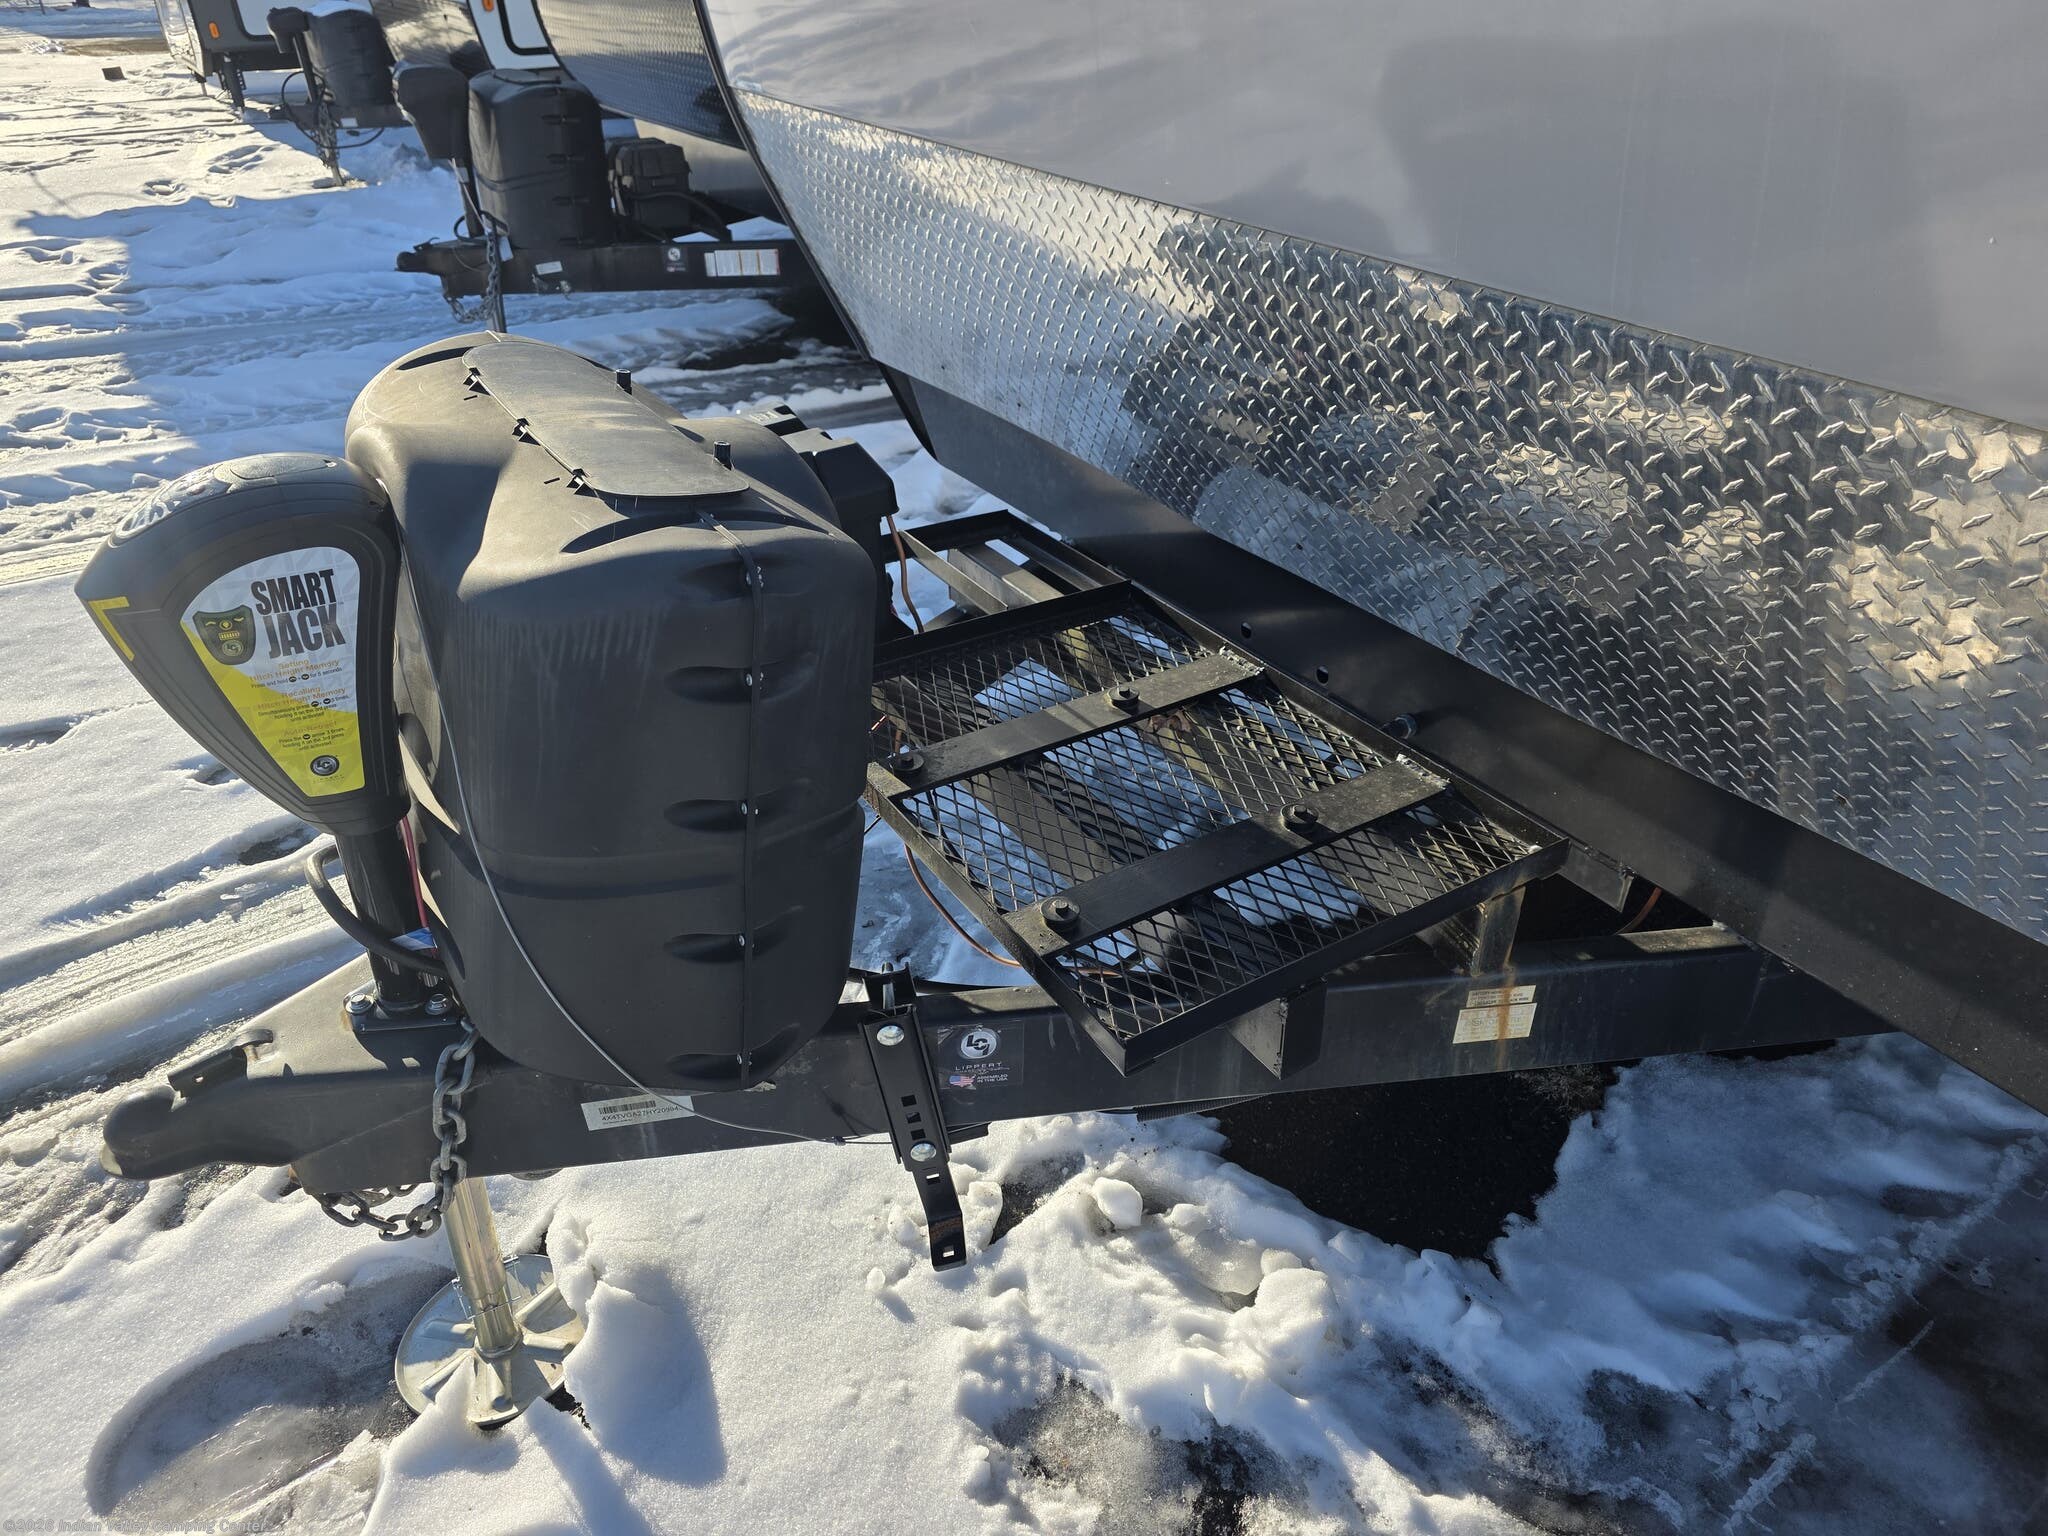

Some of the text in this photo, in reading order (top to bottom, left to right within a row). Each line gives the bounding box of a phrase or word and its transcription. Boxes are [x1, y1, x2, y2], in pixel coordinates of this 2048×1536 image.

[251, 568, 337, 616] SMART
[262, 603, 346, 660] JACK
[275, 666, 304, 678] Height
[305, 659, 340, 672] Memory
[278, 659, 309, 670] Setting
[312, 687, 346, 700] Memory
[955, 1062, 1002, 1071] LIPPERT
